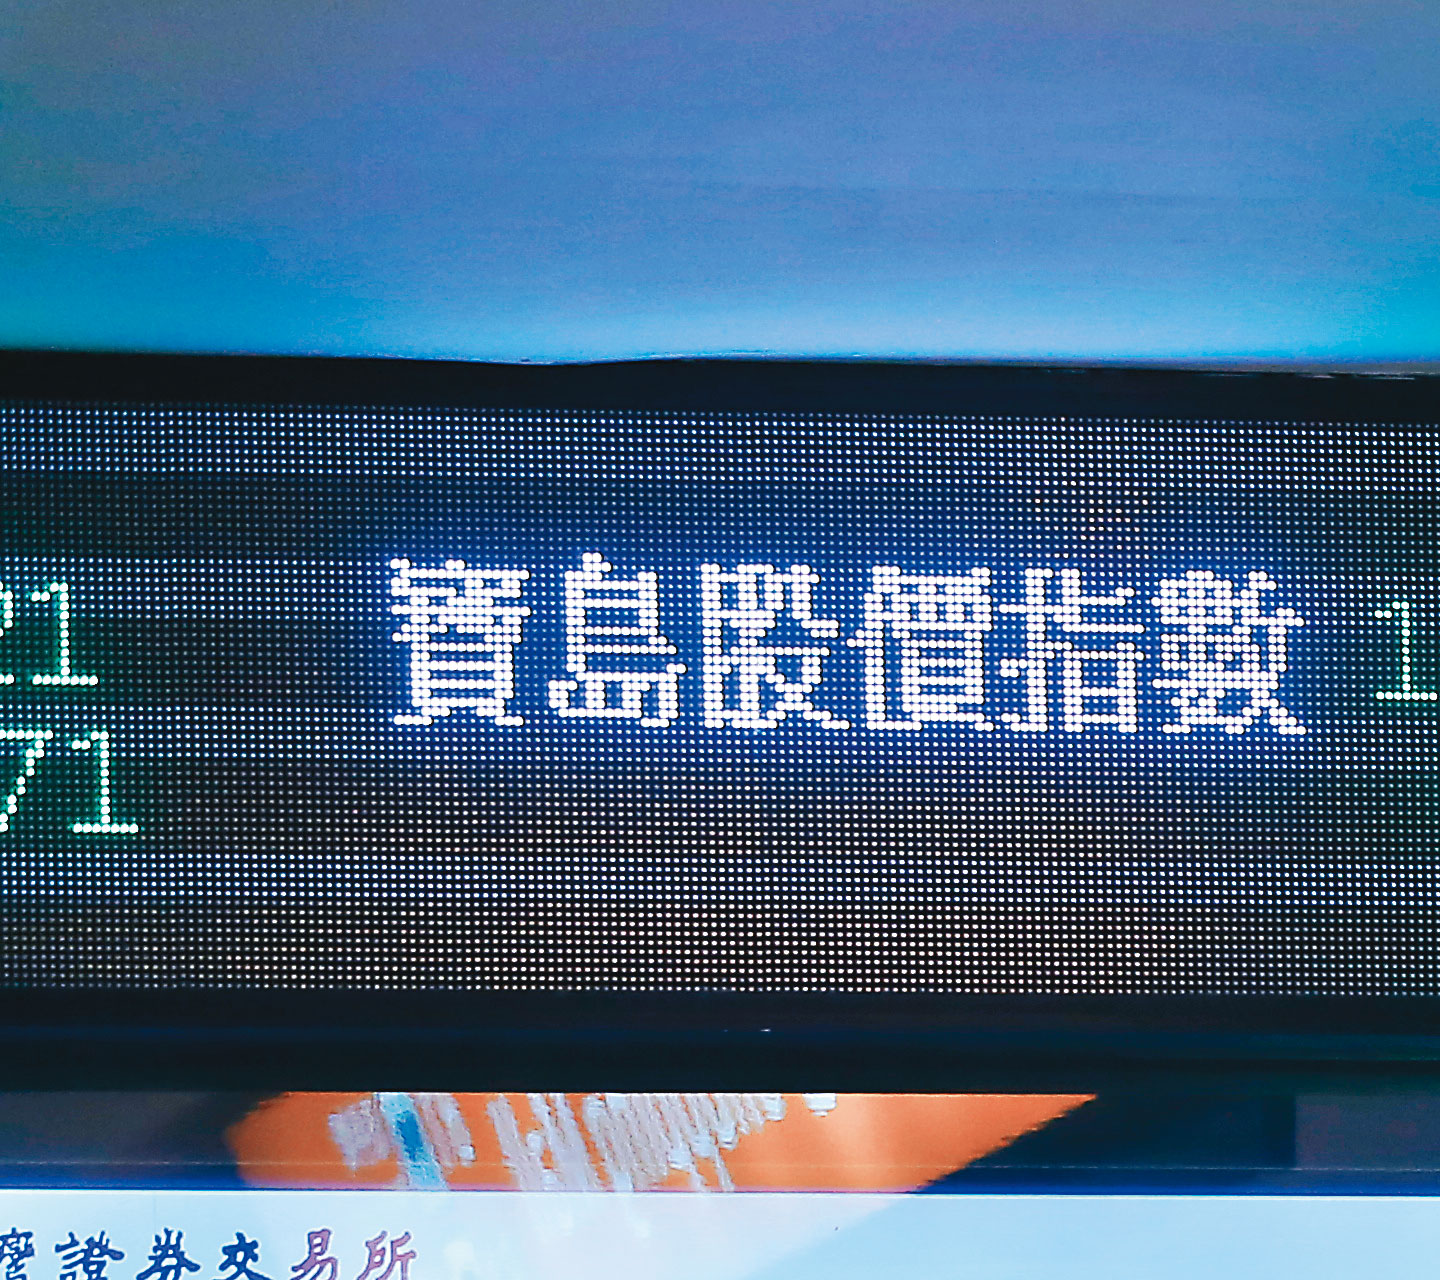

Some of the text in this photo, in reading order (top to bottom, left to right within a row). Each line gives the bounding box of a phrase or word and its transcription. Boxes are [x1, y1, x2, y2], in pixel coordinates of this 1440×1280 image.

[0, 582, 98, 685] 1
[392, 552, 1305, 735] 寶島股價指數
